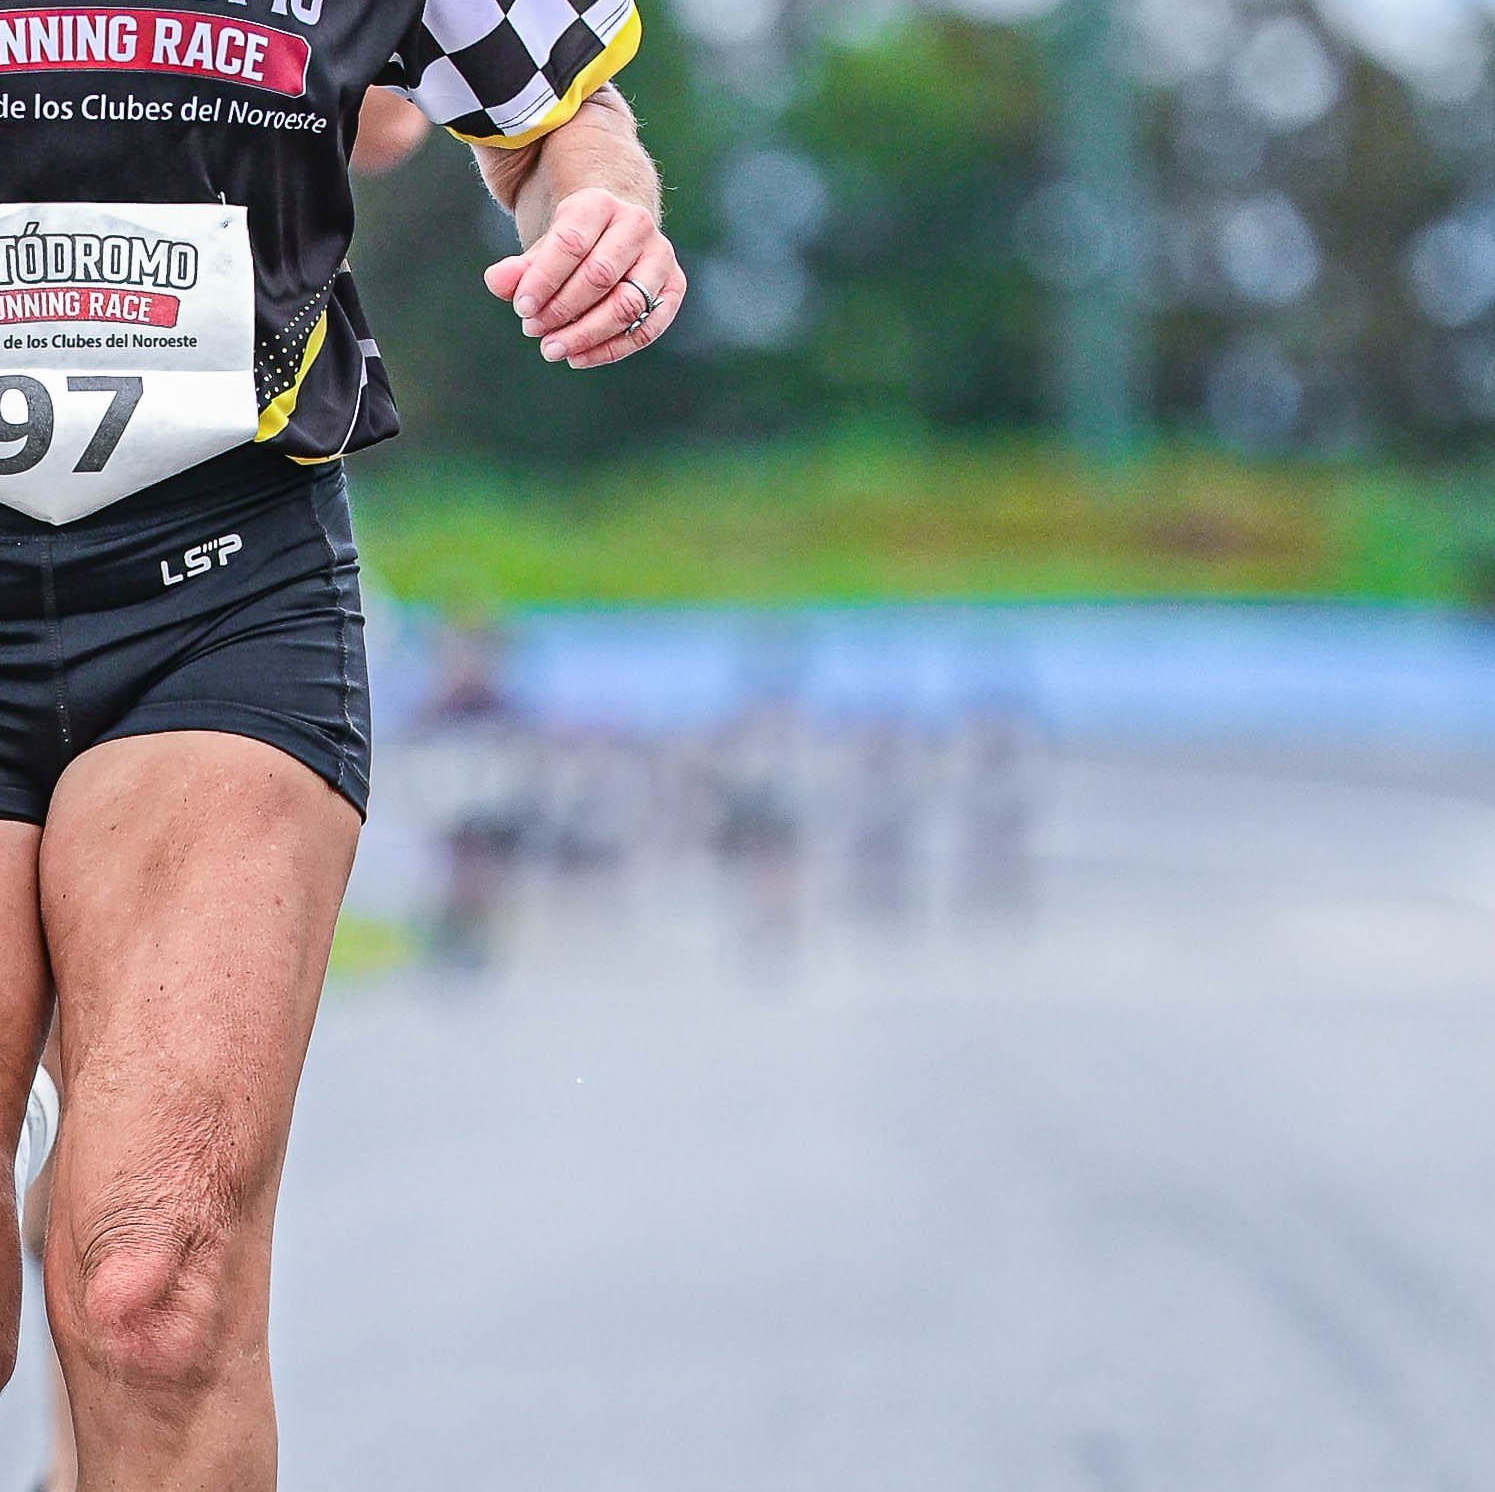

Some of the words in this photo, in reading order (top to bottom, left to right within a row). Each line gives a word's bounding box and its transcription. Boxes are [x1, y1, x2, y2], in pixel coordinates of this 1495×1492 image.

[152, 18, 270, 81] RACE
[34, 93, 73, 120] los
[81, 94, 173, 121] Clubes
[180, 96, 221, 122] del
[227, 100, 327, 134] Noroeste
[89, 292, 153, 323] RACE
[4, 335, 24, 349] de
[27, 335, 48, 349] los
[52, 334, 102, 349] Clubes
[105, 334, 128, 348] del
[132, 334, 197, 348] Noroeste
[160, 533, 243, 586] LSP
